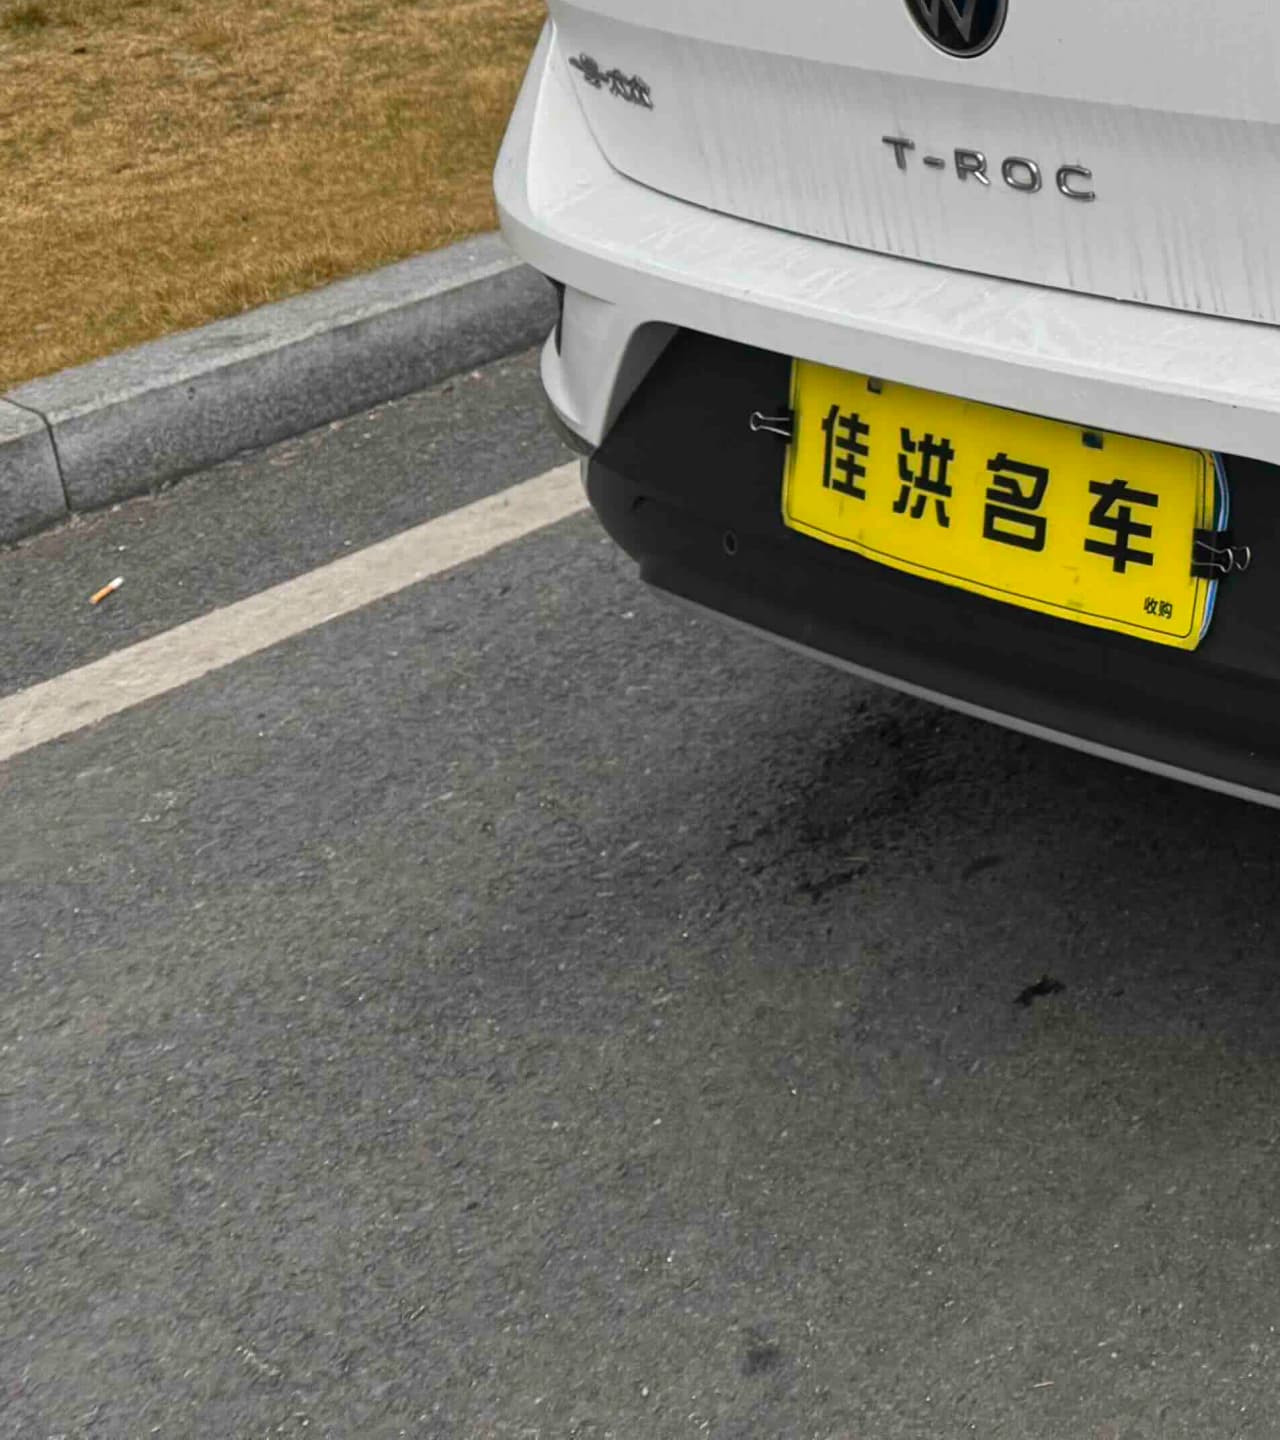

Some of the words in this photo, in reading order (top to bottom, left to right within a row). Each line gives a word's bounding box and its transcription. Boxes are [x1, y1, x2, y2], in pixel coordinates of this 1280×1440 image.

[881, 135, 1096, 201] T-ROC
[820, 403, 1160, 574] 佳洪名车
[1143, 595, 1174, 620] 收购
